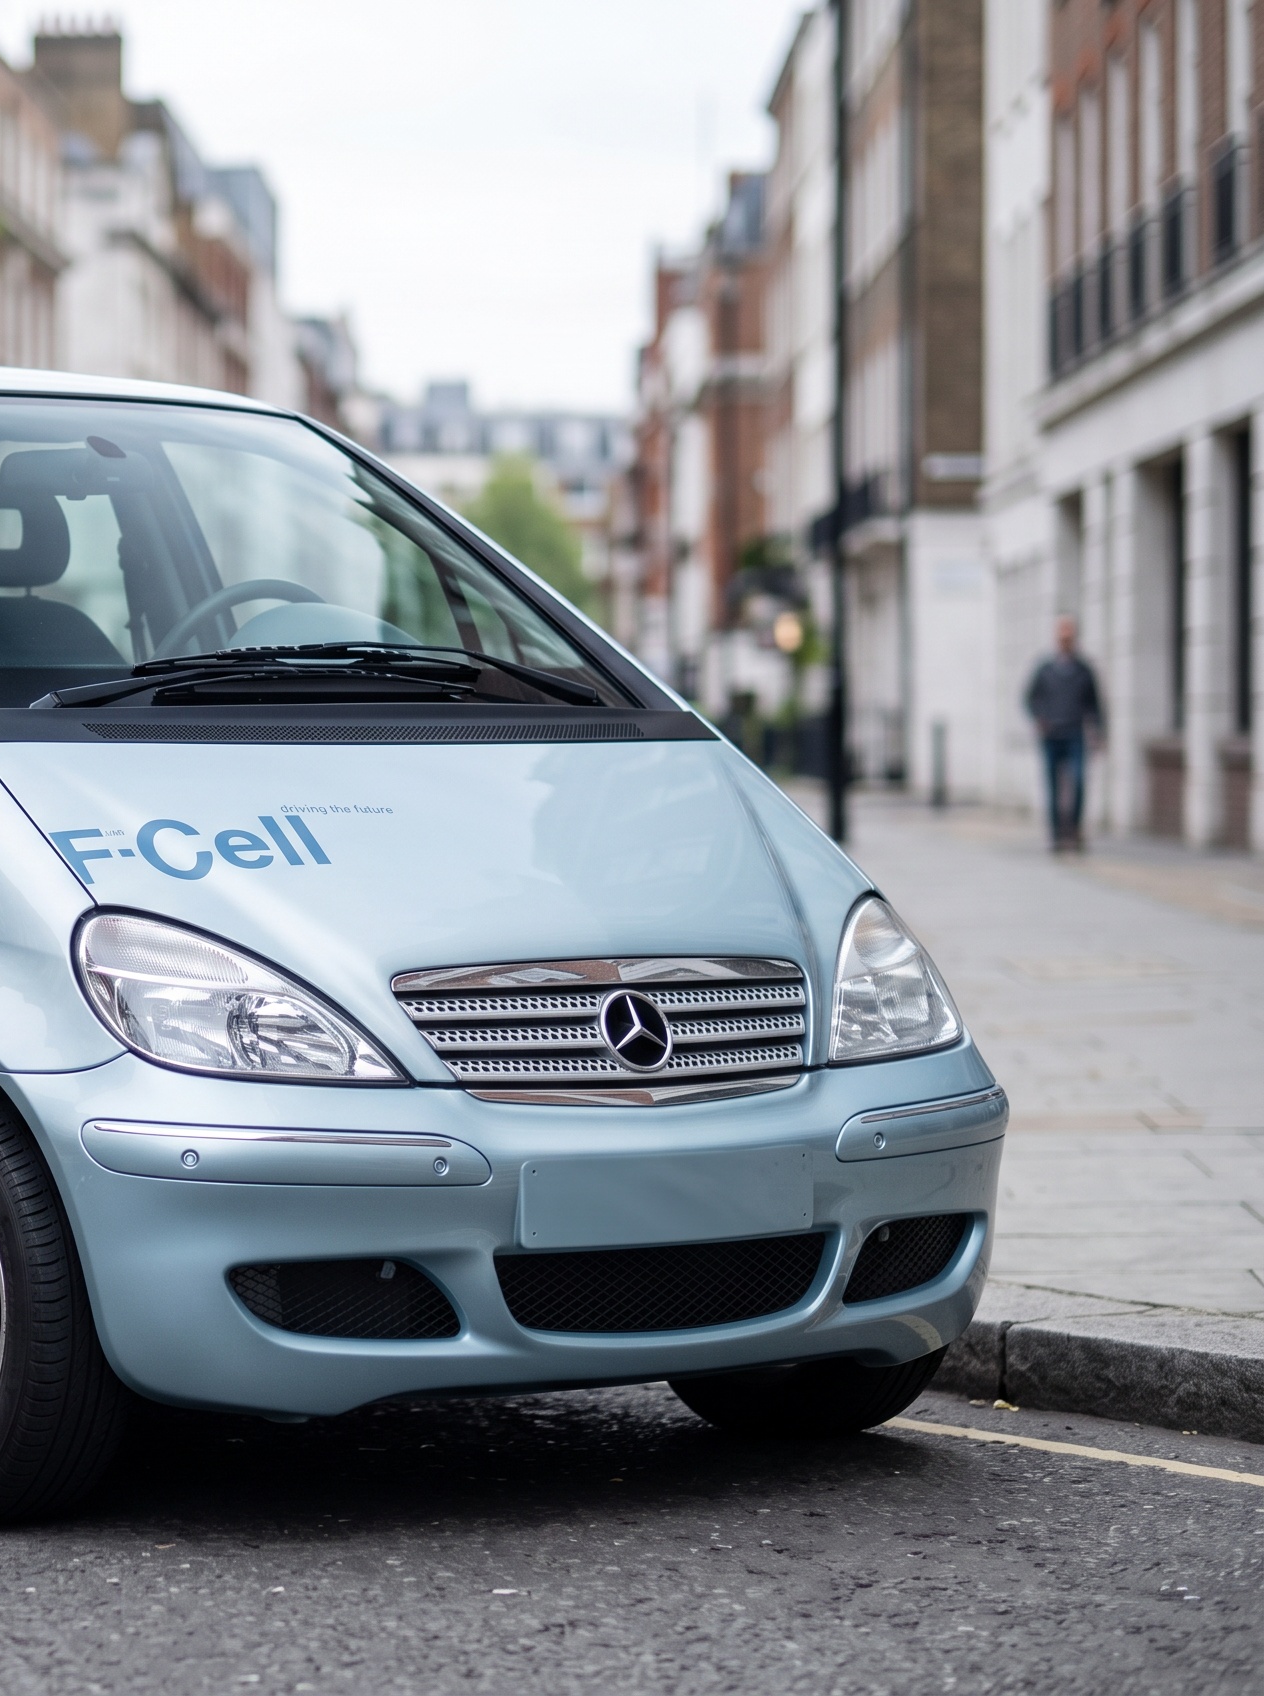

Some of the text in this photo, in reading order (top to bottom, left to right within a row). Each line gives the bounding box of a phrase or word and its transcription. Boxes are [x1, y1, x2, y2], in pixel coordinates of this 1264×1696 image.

[280, 804, 394, 815] driving the future
[48, 815, 332, 885] F-Cell
